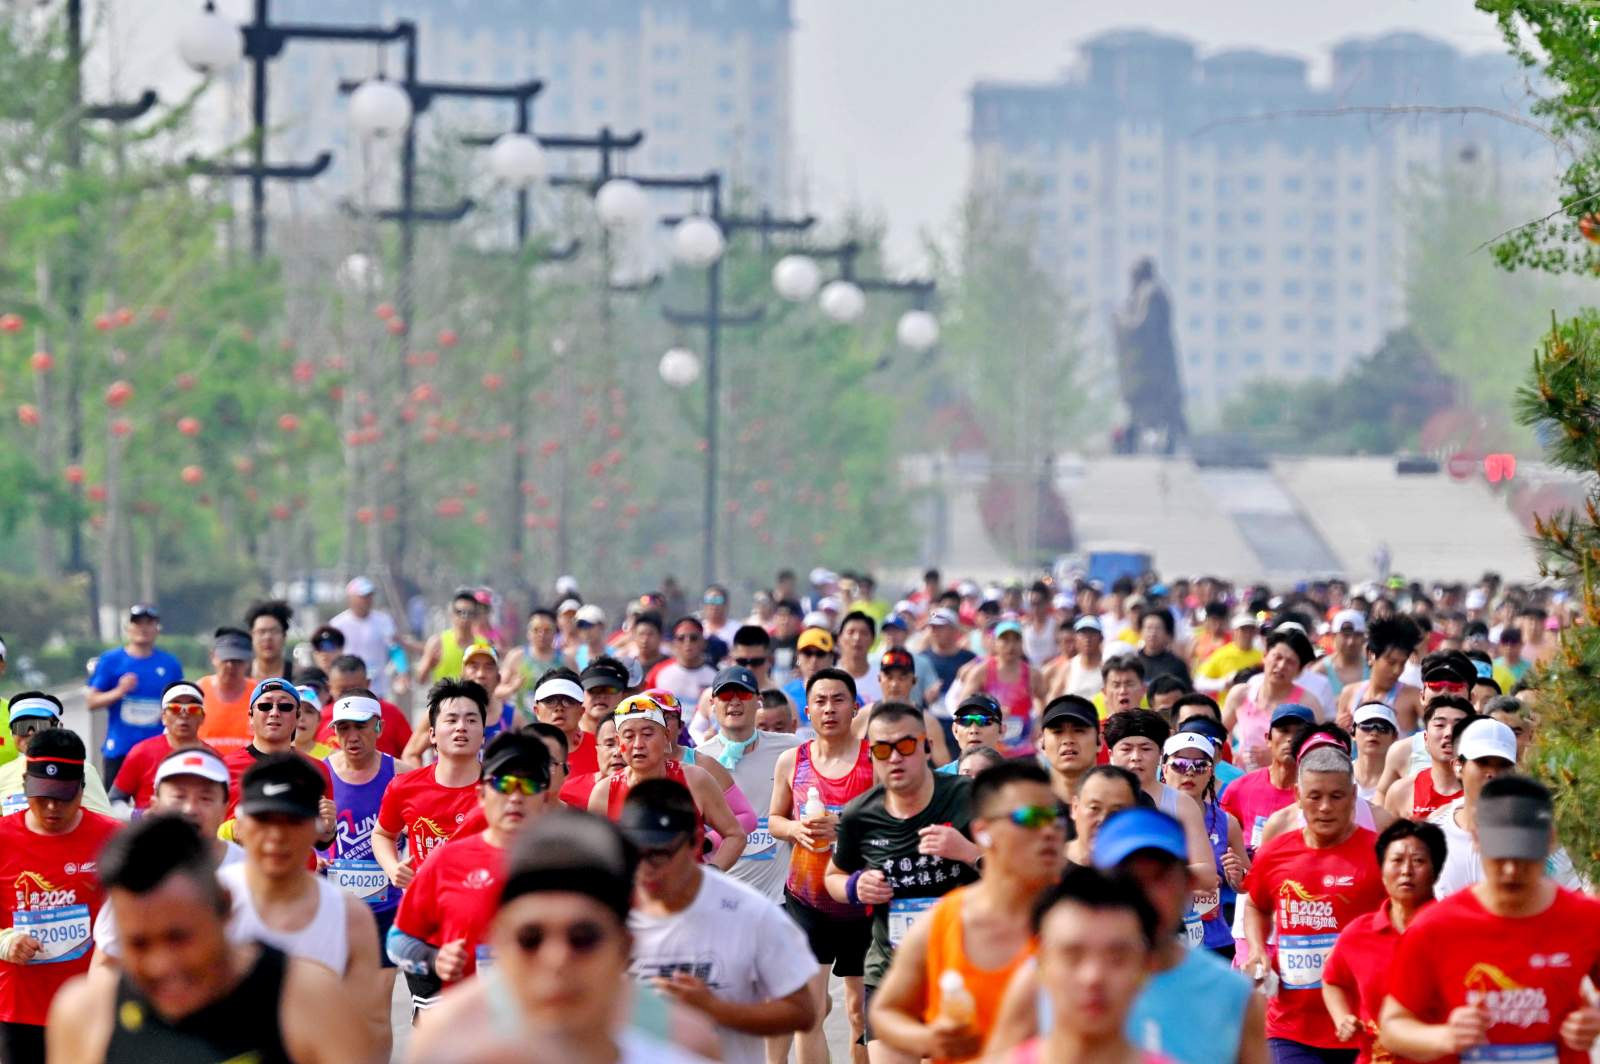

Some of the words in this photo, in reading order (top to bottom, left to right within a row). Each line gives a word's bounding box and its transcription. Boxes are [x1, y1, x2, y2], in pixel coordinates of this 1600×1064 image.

[340, 874, 385, 887] C40203
[39, 889, 76, 906] 2026
[1299, 901, 1333, 916] 2026
[29, 922, 87, 944] B20905
[1287, 953, 1328, 969] B209
